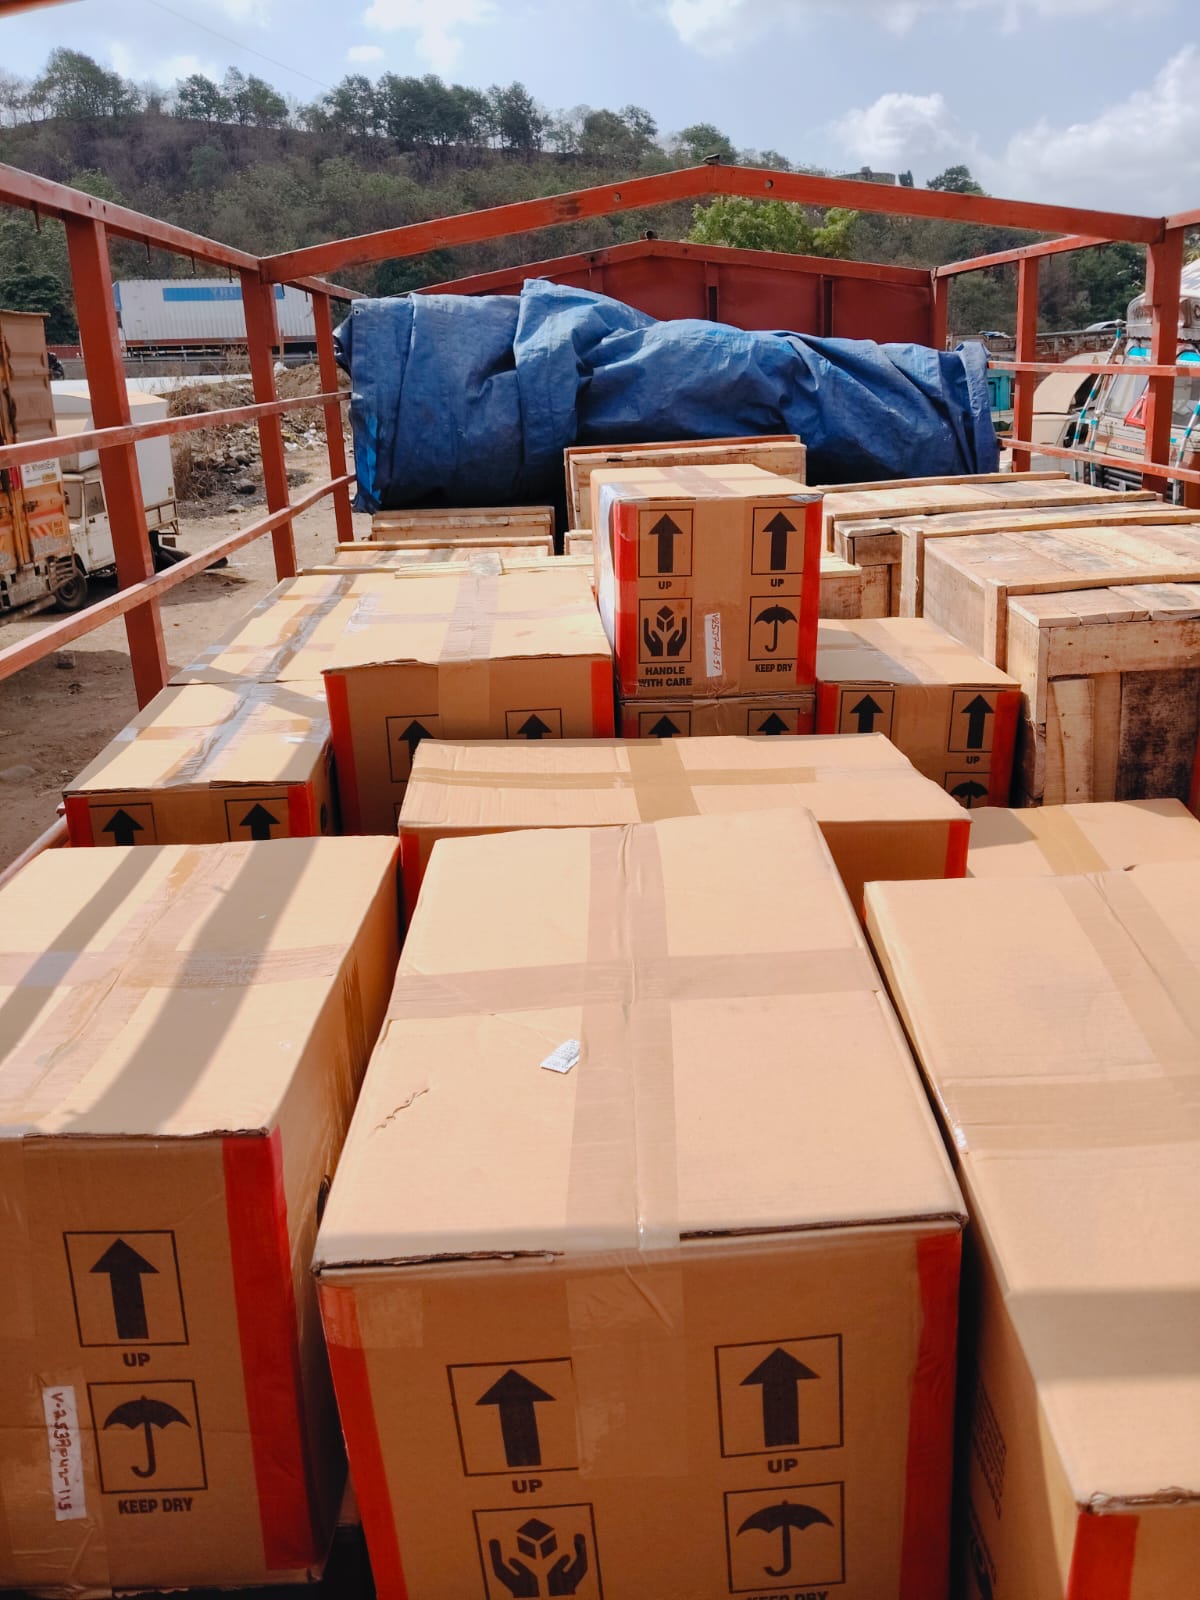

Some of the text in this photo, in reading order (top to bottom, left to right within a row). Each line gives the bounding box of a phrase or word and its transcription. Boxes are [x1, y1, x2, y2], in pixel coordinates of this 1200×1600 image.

[658, 581, 672, 590] UP
[770, 578, 784, 588] UP
[645, 666, 685, 675] HANDLE
[755, 663, 793, 673] KEEP DRY
[638, 677, 693, 687] WITH CARE
[966, 756, 980, 764] UP
[123, 1352, 151, 1368] UP
[767, 1458, 799, 1473] UP
[512, 1479, 543, 1494] UP
[118, 1497, 193, 1514] KEEP DRY
